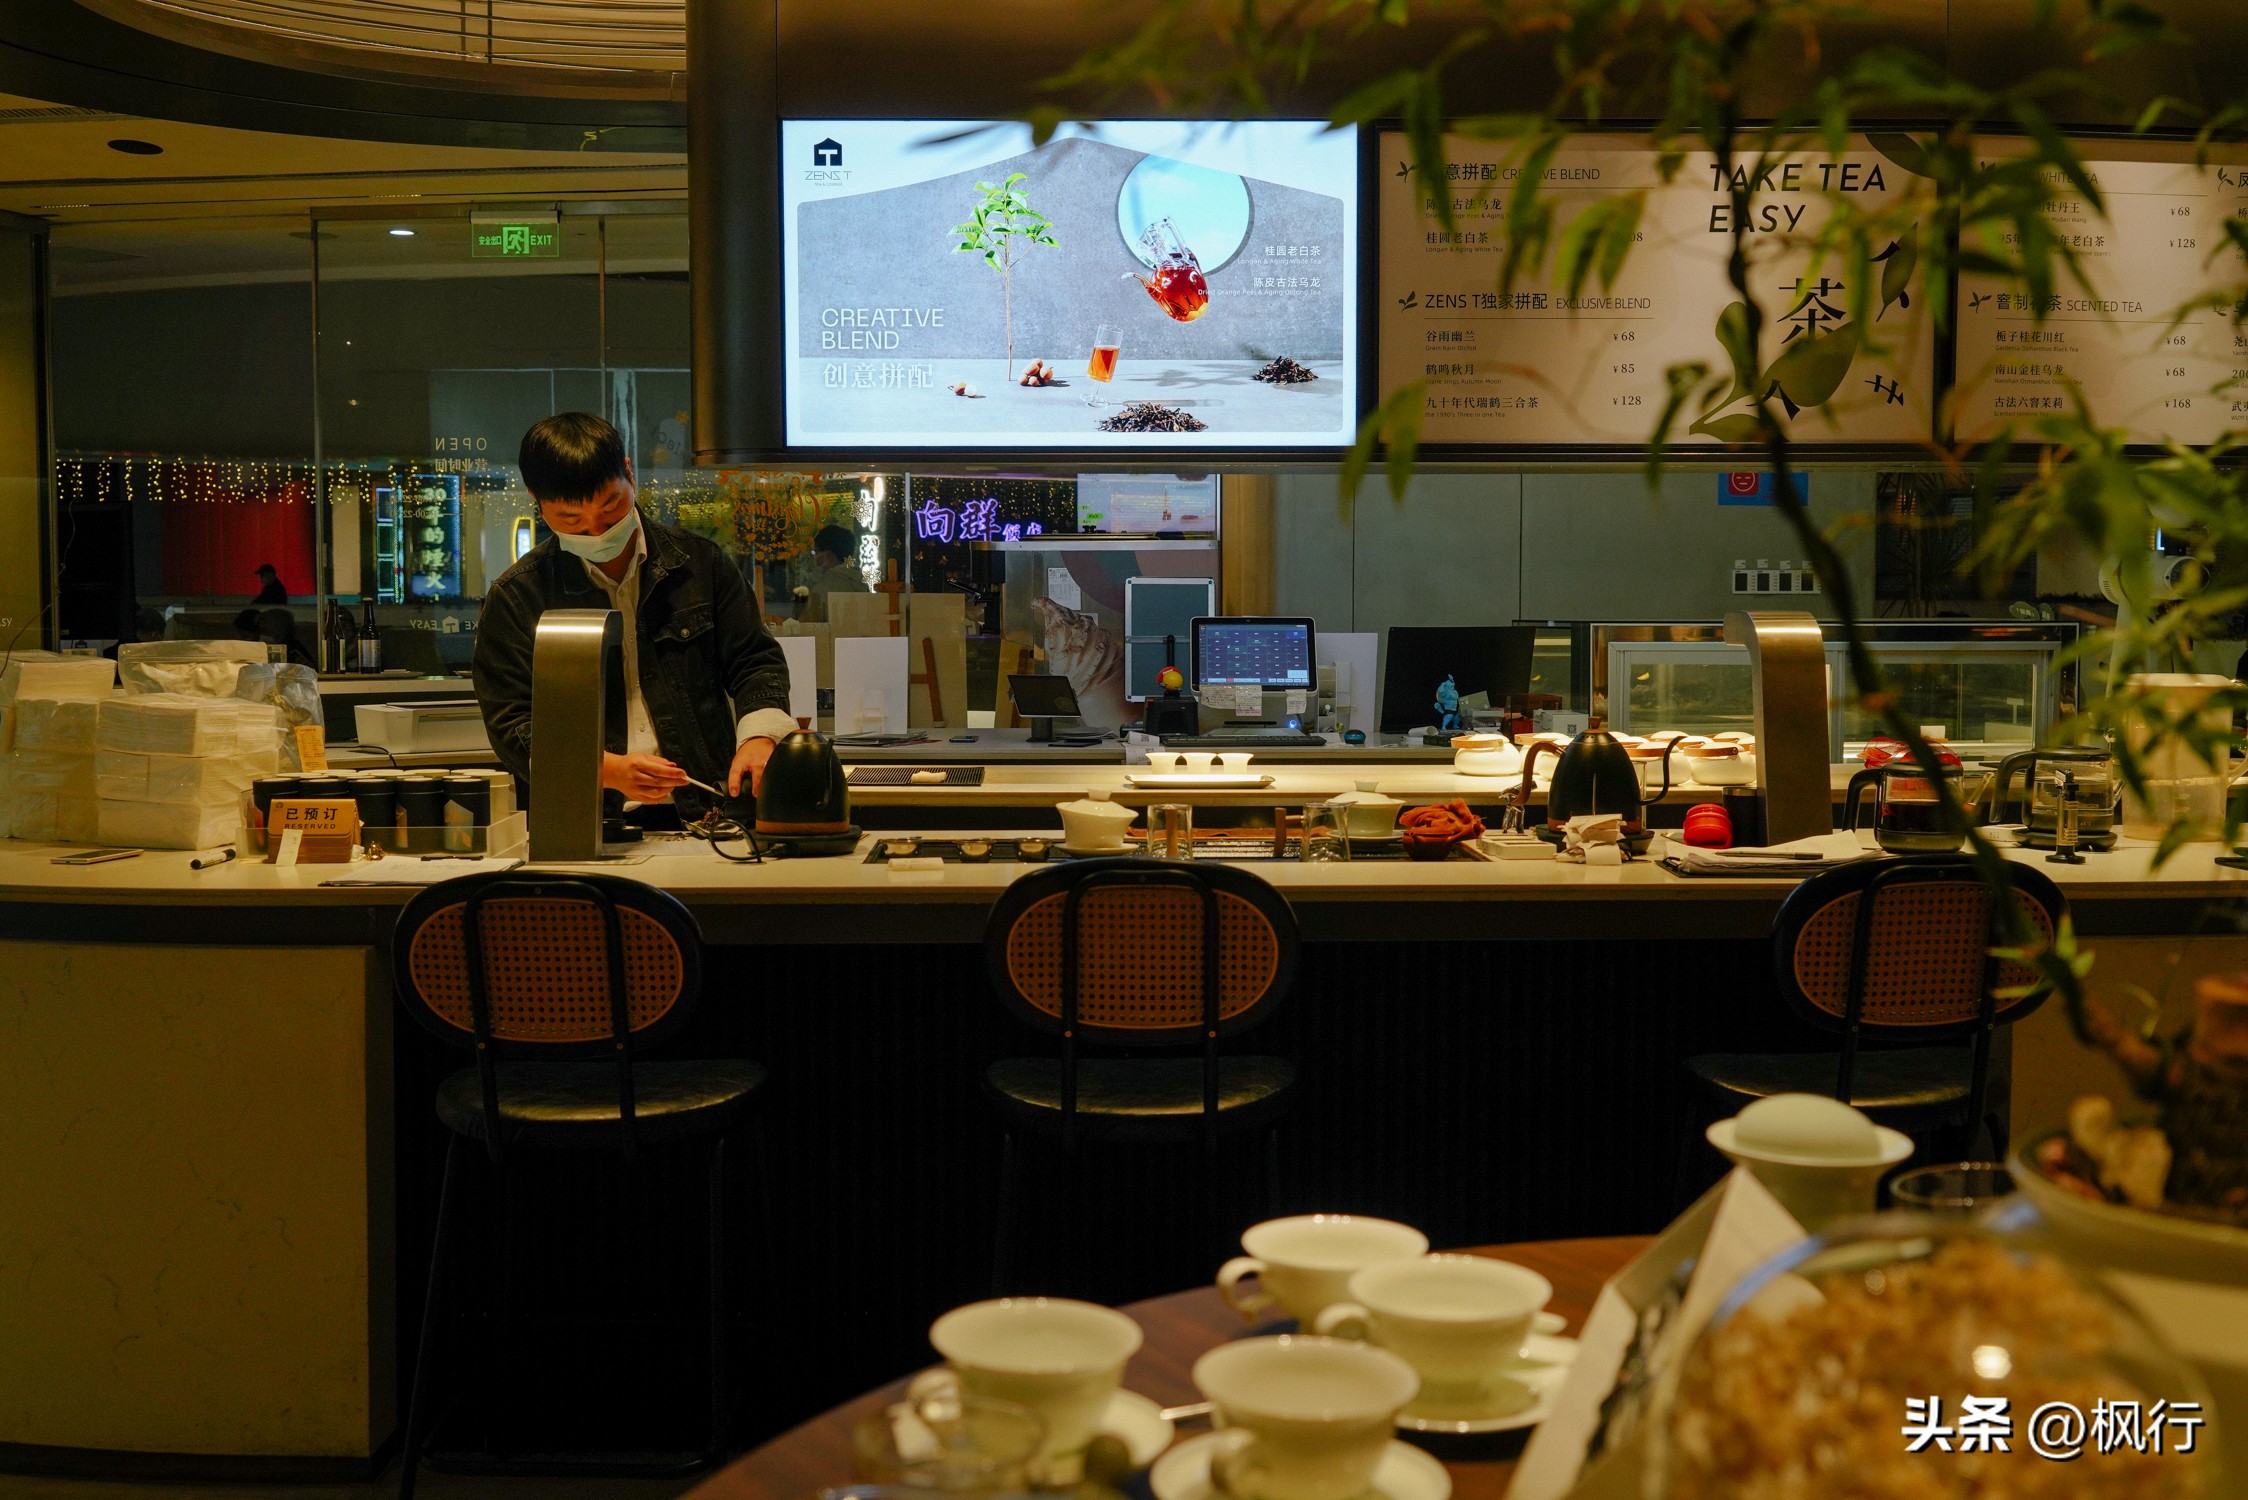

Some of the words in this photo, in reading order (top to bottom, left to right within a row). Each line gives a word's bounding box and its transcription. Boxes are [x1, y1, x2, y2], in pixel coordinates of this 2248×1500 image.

[1446, 163, 1498, 181] 意拼配
[1560, 168, 1600, 180] BLEND
[1709, 163, 1803, 192] TAKE
[1818, 163, 1887, 192] TEA
[1426, 198, 1502, 211] 陈古法乌龙
[530, 235, 552, 246] EXIT
[1426, 231, 1489, 244] 桂圆老白茶
[1264, 245, 1321, 257] 桂圆老白茶
[1253, 277, 1321, 288] 陈皮古法乌龙
[1425, 293, 1467, 309] ZENS
[1556, 297, 1612, 309] EXCLUSIVE
[1615, 297, 1651, 309] BLEND
[1996, 293, 2062, 311] 窨制茶
[2066, 299, 2119, 312] SCENTED
[2121, 301, 2143, 312] TEA
[821, 307, 945, 327] CREATIVE
[1776, 277, 1847, 346] 茶
[821, 330, 900, 350] BLEND
[1425, 330, 1476, 342] 谷雨幽兰
[823, 362, 935, 390] 创意拼配
[286, 807, 338, 821] 已预订
